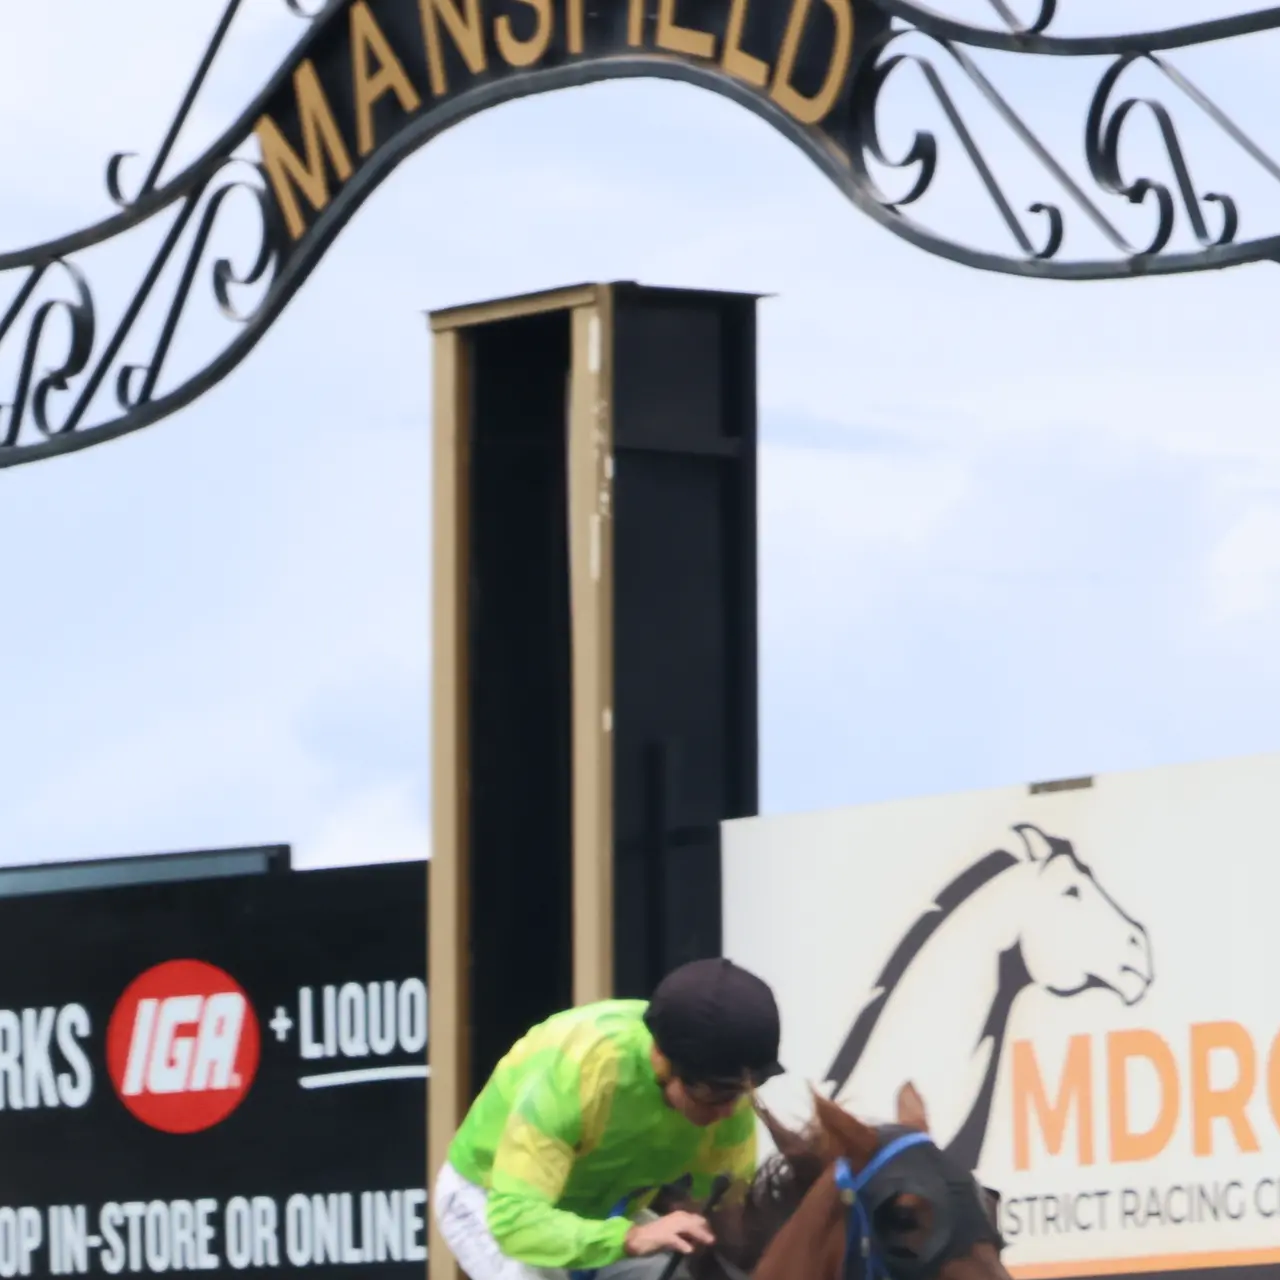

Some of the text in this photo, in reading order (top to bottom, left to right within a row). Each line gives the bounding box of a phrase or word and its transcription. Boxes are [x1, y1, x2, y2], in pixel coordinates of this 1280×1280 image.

[122, 992, 246, 1096] IGA
[48, 1198, 220, 1275] IN-STORE
[225, 1195, 280, 1269] OR
[285, 1188, 428, 1267] ONLINE
[1121, 1181, 1246, 1230] RACING
